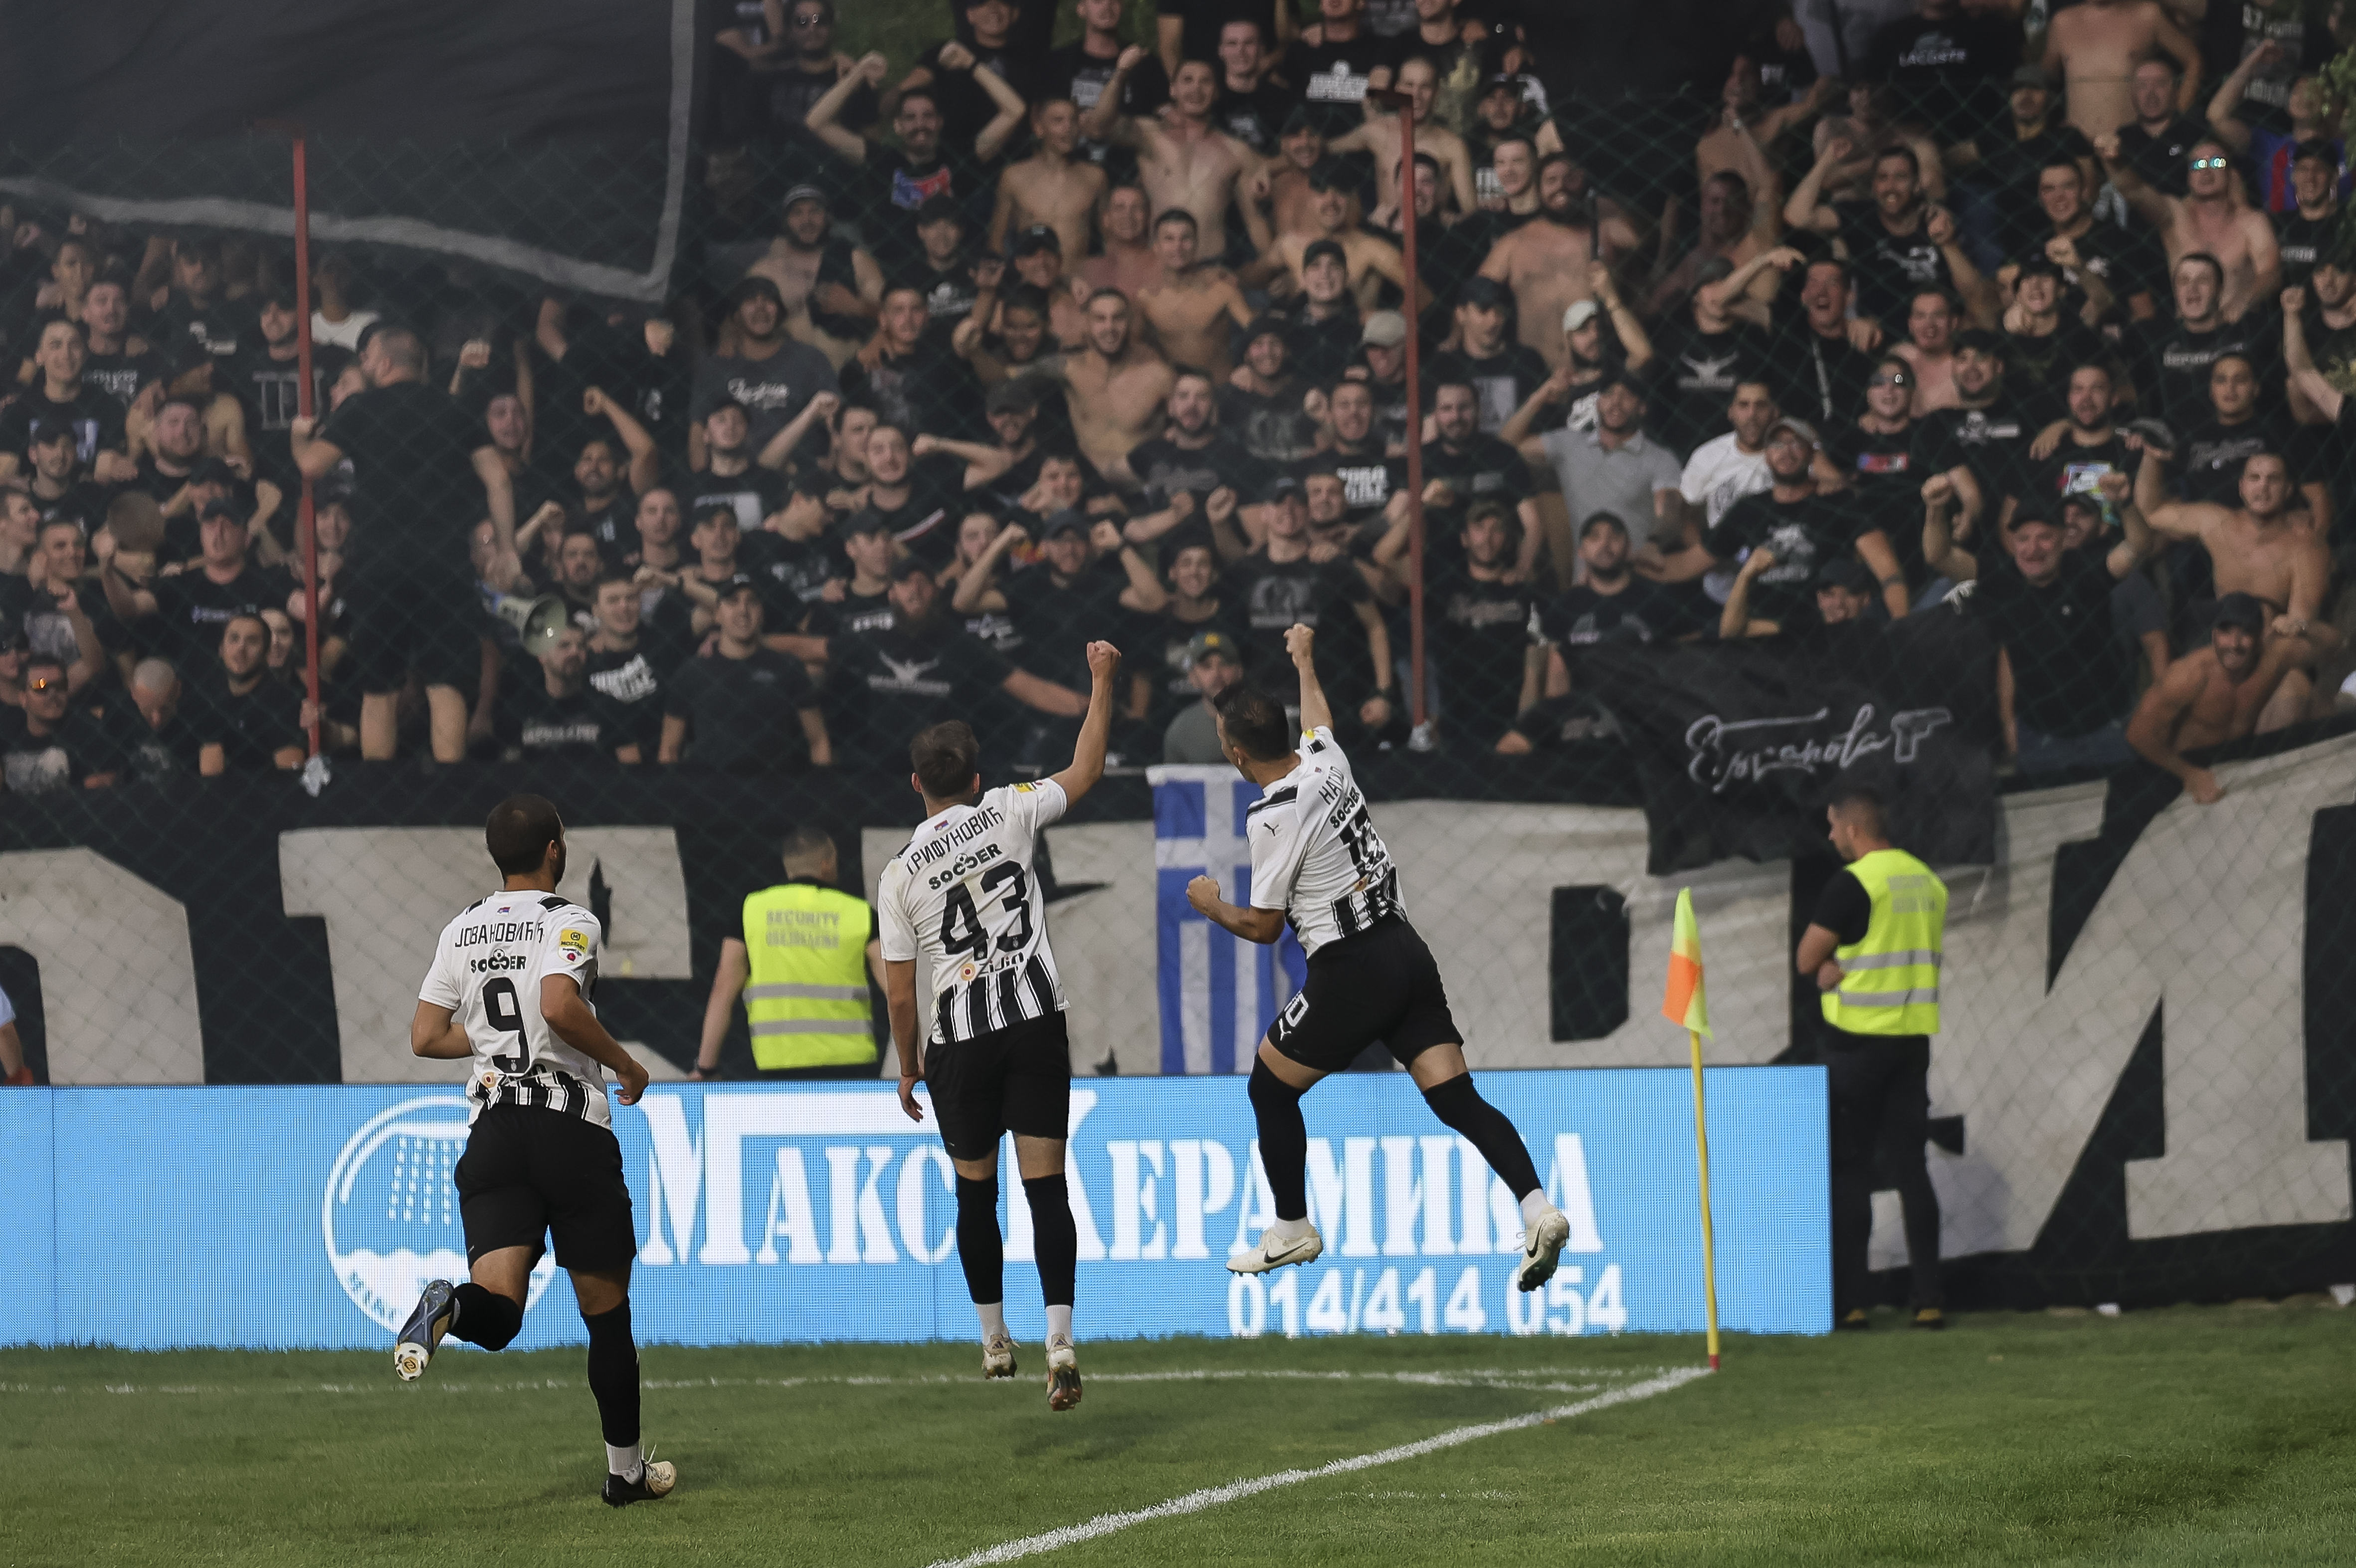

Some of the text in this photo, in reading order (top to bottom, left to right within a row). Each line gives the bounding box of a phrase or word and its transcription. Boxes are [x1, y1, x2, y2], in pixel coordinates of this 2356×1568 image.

[928, 843, 1003, 890] SOCCER
[767, 910, 840, 927] SECURITY
[939, 860, 1034, 961] 43
[455, 921, 534, 948] ЈОВАНОВИЋ
[470, 952, 527, 974] SOCCER
[482, 977, 530, 1074] 9
[1227, 1264, 1628, 1339] 014/414 054
